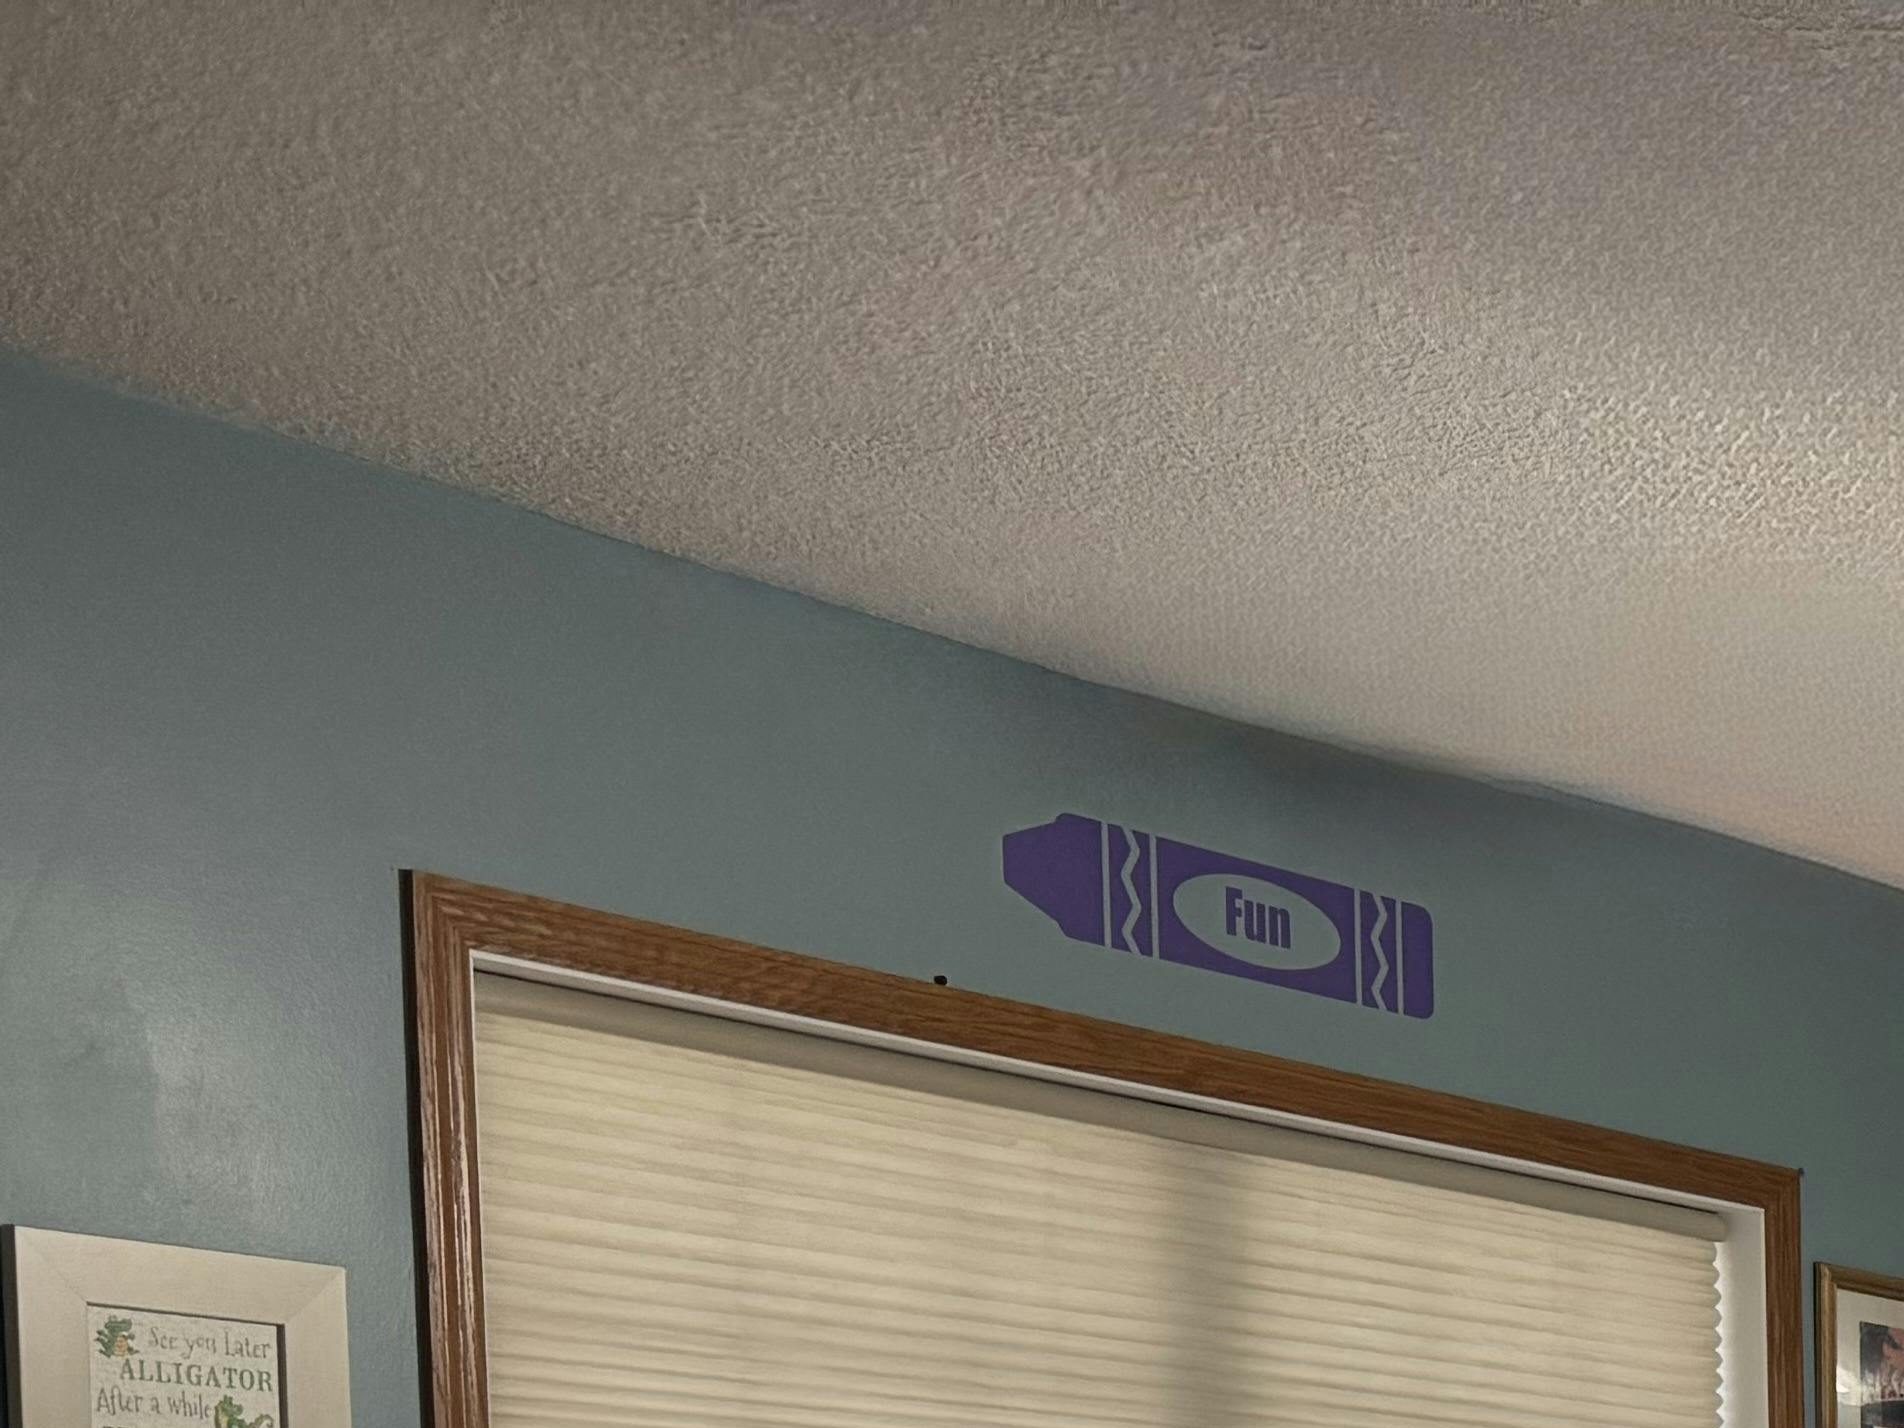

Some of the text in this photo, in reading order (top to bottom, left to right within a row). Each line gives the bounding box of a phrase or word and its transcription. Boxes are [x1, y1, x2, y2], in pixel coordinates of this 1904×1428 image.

[1224, 885, 1292, 949] Fun
[150, 1327, 272, 1360] See you Later
[119, 1357, 273, 1392] ALLIGATOR
[96, 1385, 210, 1420] After a while
